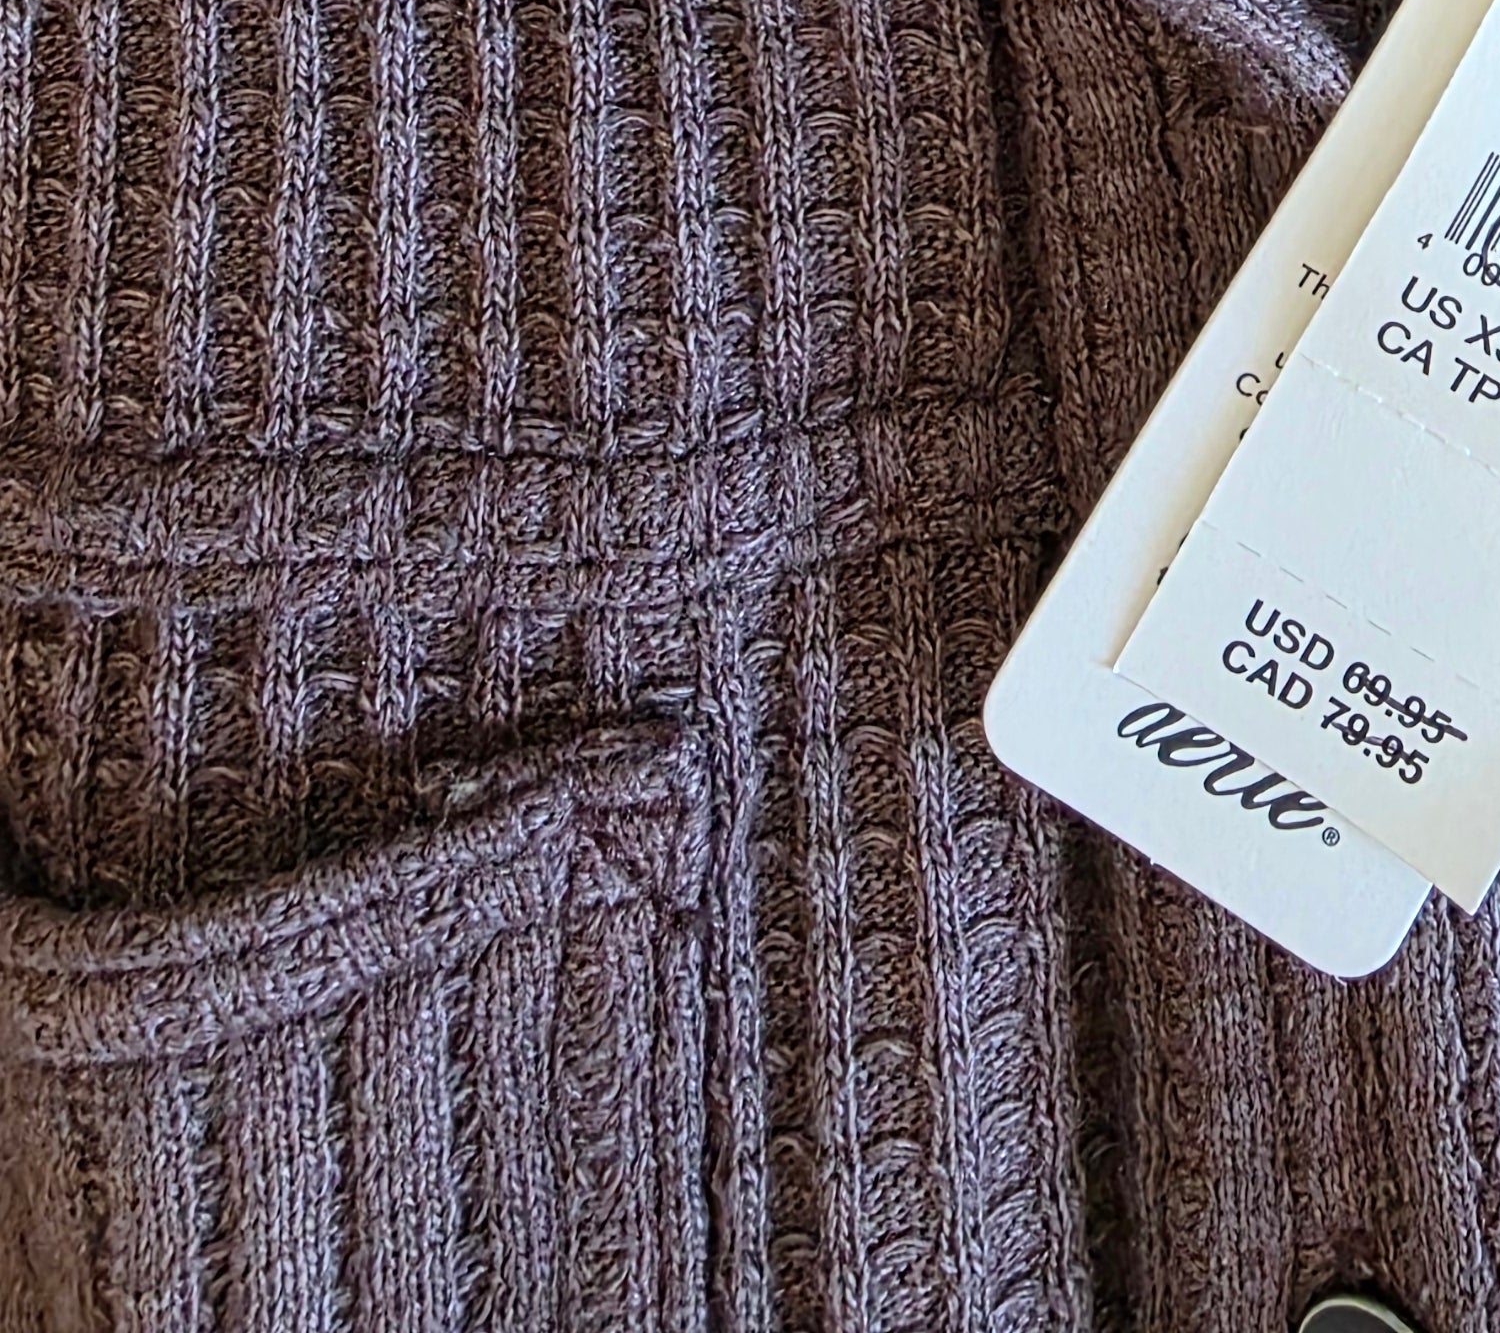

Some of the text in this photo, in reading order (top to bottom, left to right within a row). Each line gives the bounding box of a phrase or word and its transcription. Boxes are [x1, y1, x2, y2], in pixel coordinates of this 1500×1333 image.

[1416, 232, 1434, 250] 4
[1399, 275, 1465, 330] US
[1377, 321, 1434, 376] CA
[1244, 598, 1452, 744] USD 69.95
[1221, 640, 1430, 785] CAD 79.95
